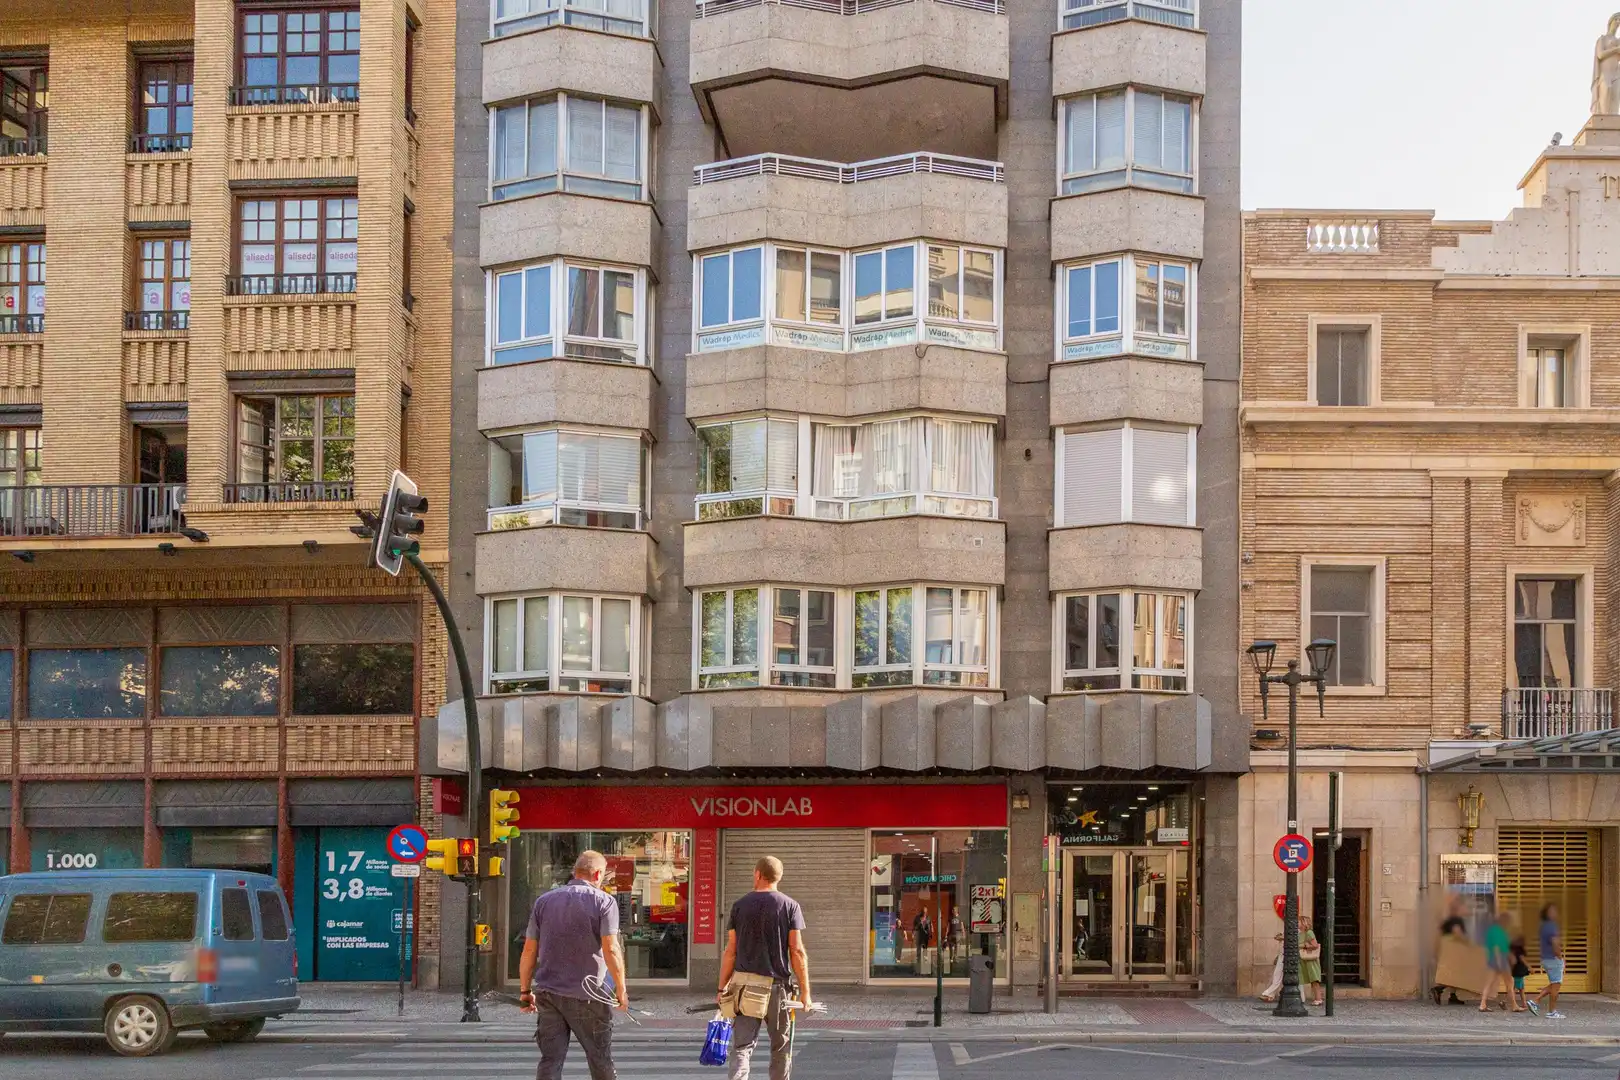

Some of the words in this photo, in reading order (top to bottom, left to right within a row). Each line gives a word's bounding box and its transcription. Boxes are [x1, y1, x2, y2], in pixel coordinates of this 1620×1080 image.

[1599, 175, 1620, 199] T
[246, 252, 274, 262] aliseda
[288, 251, 316, 260] aliseda
[690, 796, 813, 816] VISIONLAB
[46, 853, 97, 868] 1.000
[325, 850, 365, 875] 1,7
[323, 878, 364, 902] 3,8
[978, 887, 995, 897] 2x1
[336, 920, 364, 928] cajamar
